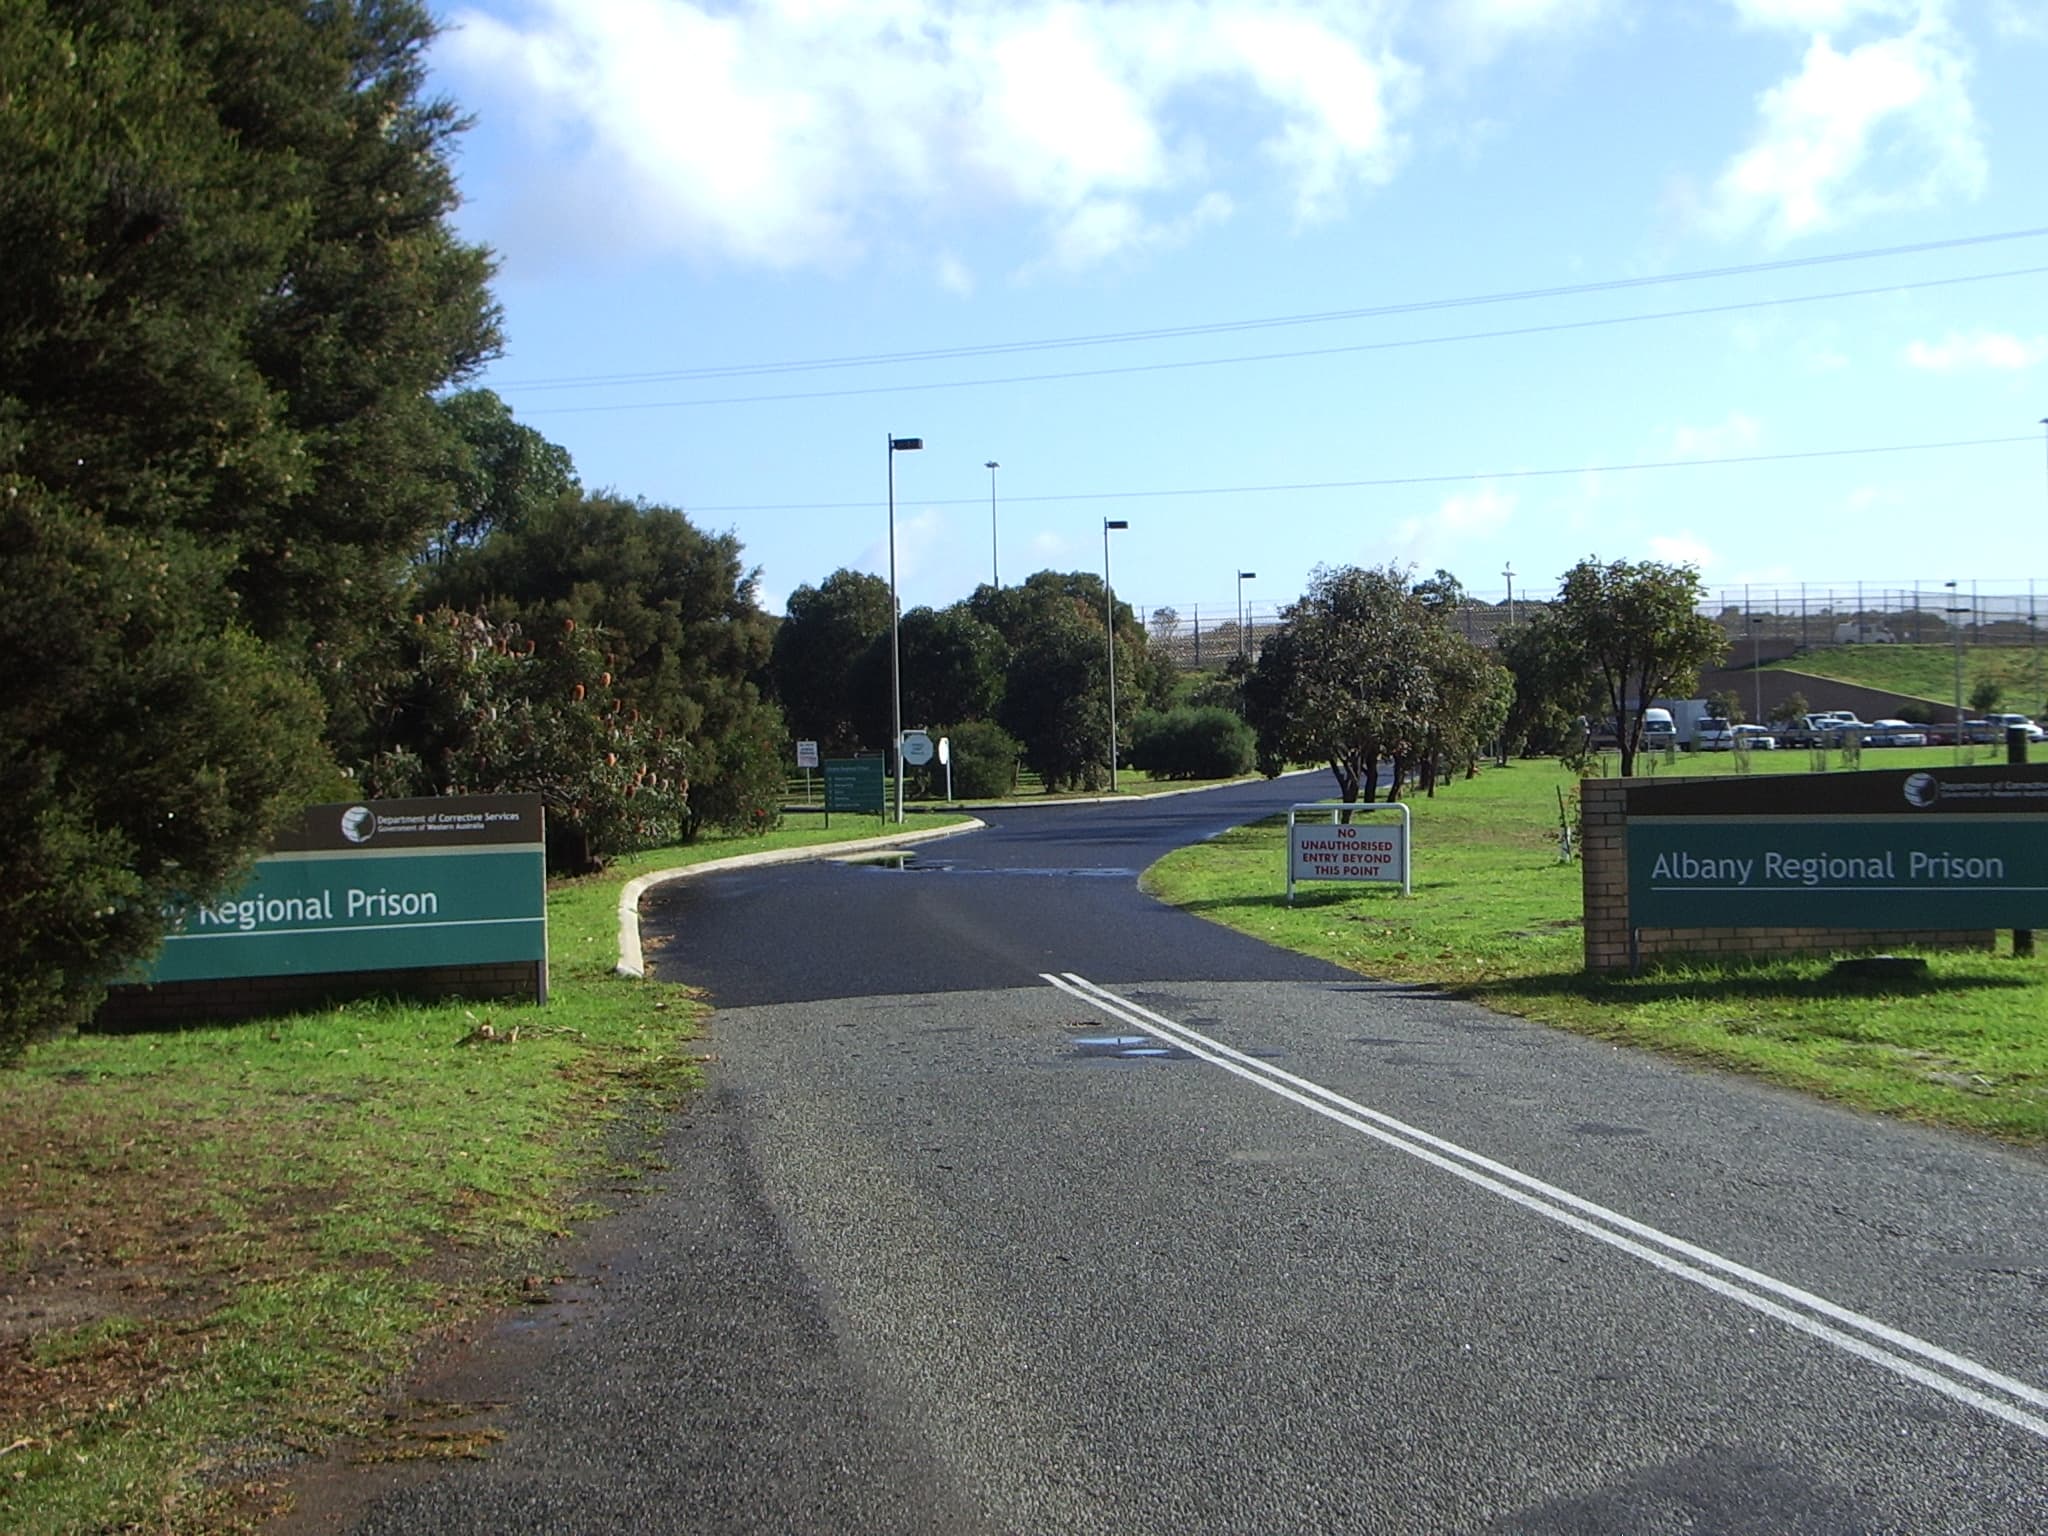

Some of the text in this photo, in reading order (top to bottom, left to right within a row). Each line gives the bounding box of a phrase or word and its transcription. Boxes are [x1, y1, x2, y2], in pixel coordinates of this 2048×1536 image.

[428, 814, 437, 822] of
[439, 813, 483, 822] Corrective
[485, 812, 519, 821] Services
[1337, 828, 1357, 839] NO
[1301, 841, 1393, 852] UNAUTHORISED
[1302, 853, 1392, 864] ENTRY BEYOND
[1314, 865, 1380, 877] THIS POINT
[1651, 850, 2004, 886] Albany Regional Prison
[347, 887, 437, 918] Prison
